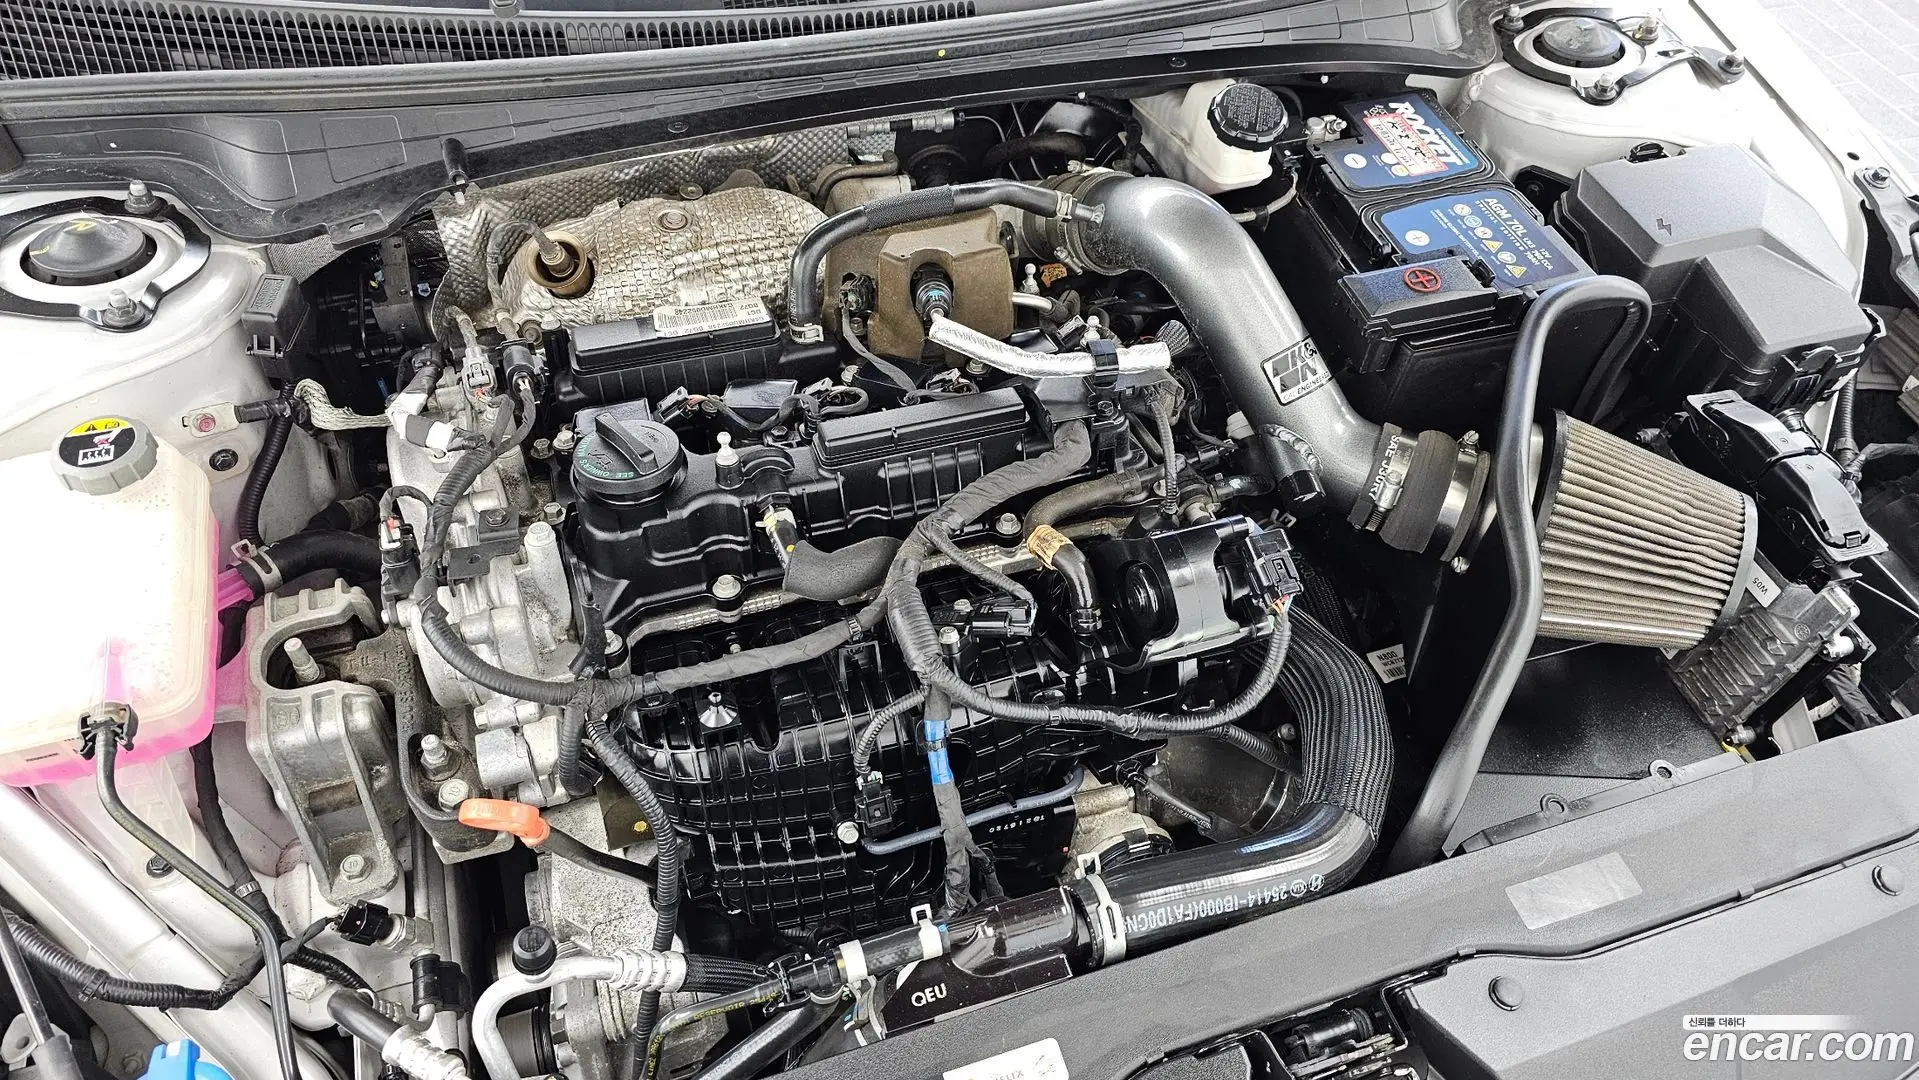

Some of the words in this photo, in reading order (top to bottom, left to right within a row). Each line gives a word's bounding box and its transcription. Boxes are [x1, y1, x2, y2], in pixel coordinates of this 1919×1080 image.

[1389, 102, 1463, 165] ROCKET
[1485, 198, 1512, 219] AGM
[1506, 219, 1527, 236] 70L
[1385, 435, 1400, 458] SAE
[615, 471, 635, 479] SEE
[1752, 576, 1769, 595] W05
[911, 983, 947, 1007] QEU
